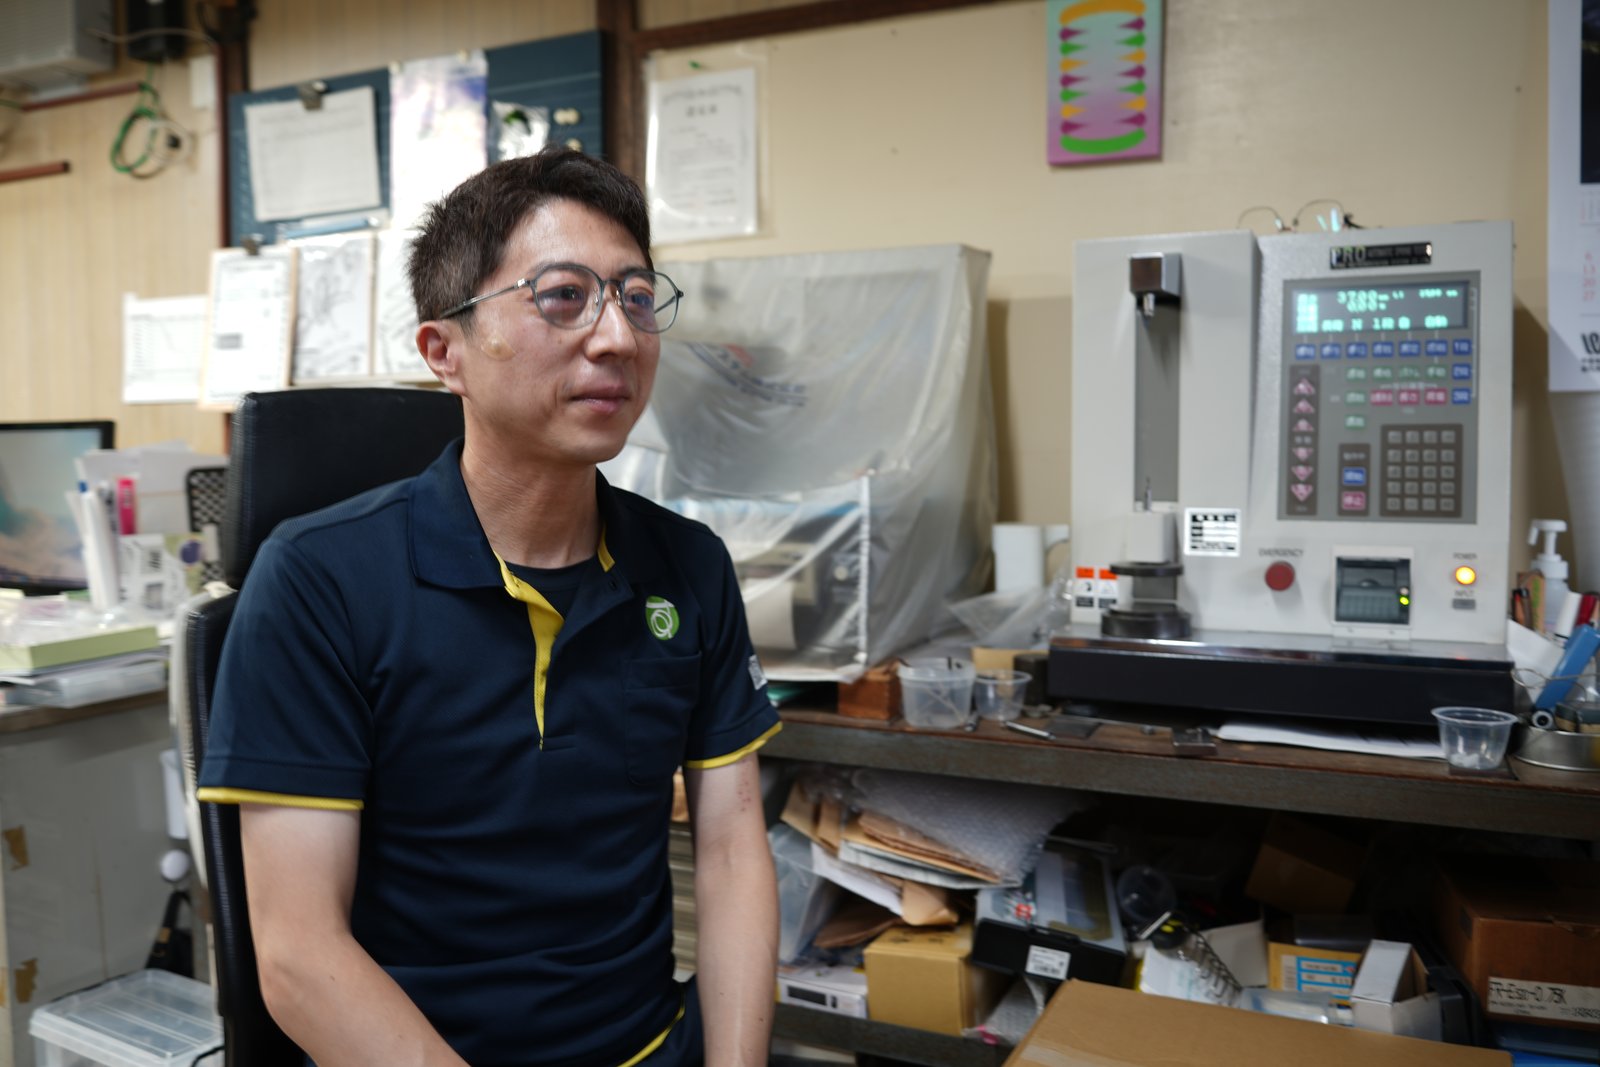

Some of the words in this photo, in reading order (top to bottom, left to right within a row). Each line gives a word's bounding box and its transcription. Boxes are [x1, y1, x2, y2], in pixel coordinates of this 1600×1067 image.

[1331, 245, 1367, 266] PRO
[1583, 278, 1596, 287] 20
[1257, 547, 1304, 557] EMERGENCY
